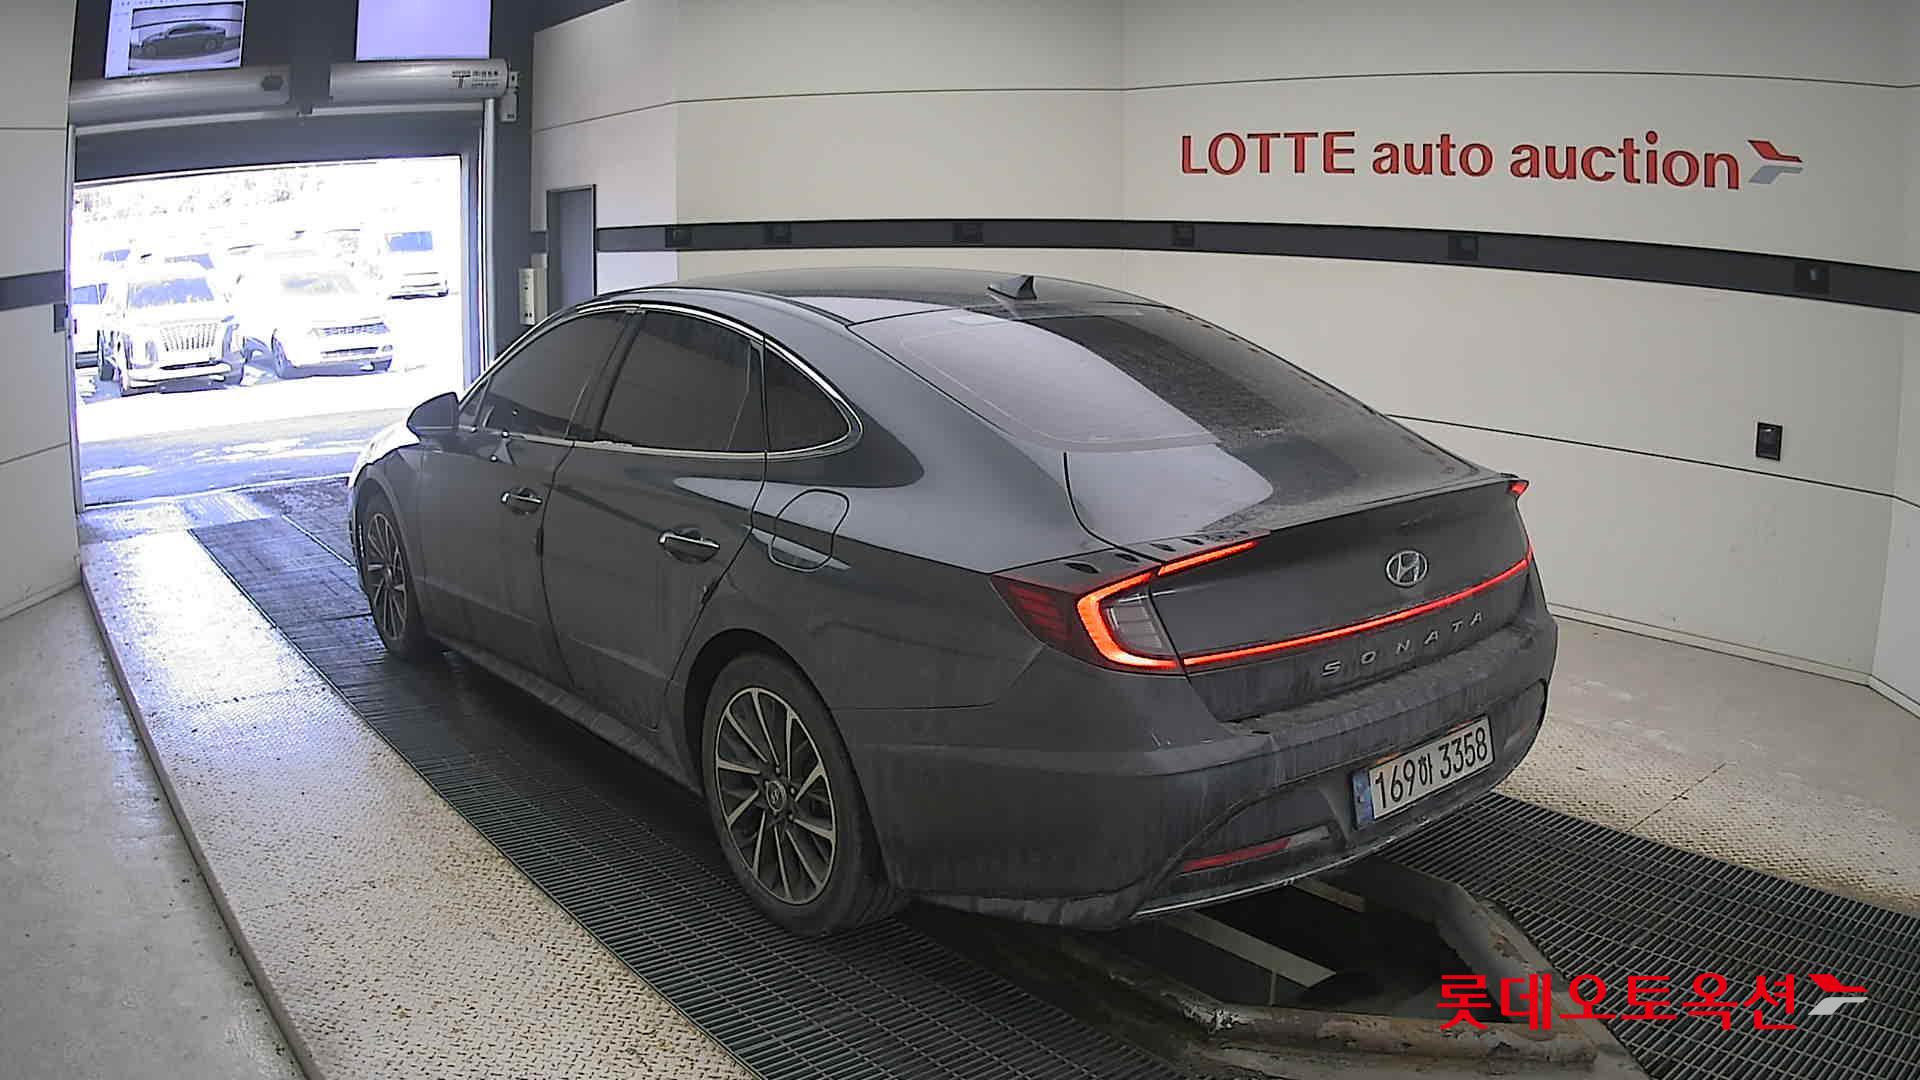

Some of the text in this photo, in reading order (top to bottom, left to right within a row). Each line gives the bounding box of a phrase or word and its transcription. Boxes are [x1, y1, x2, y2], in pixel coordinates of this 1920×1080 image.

[1181, 131, 1740, 190] LOTTE auto auction
[1322, 610, 1483, 676] SONATA
[1375, 727, 1487, 808] 169하 3358
